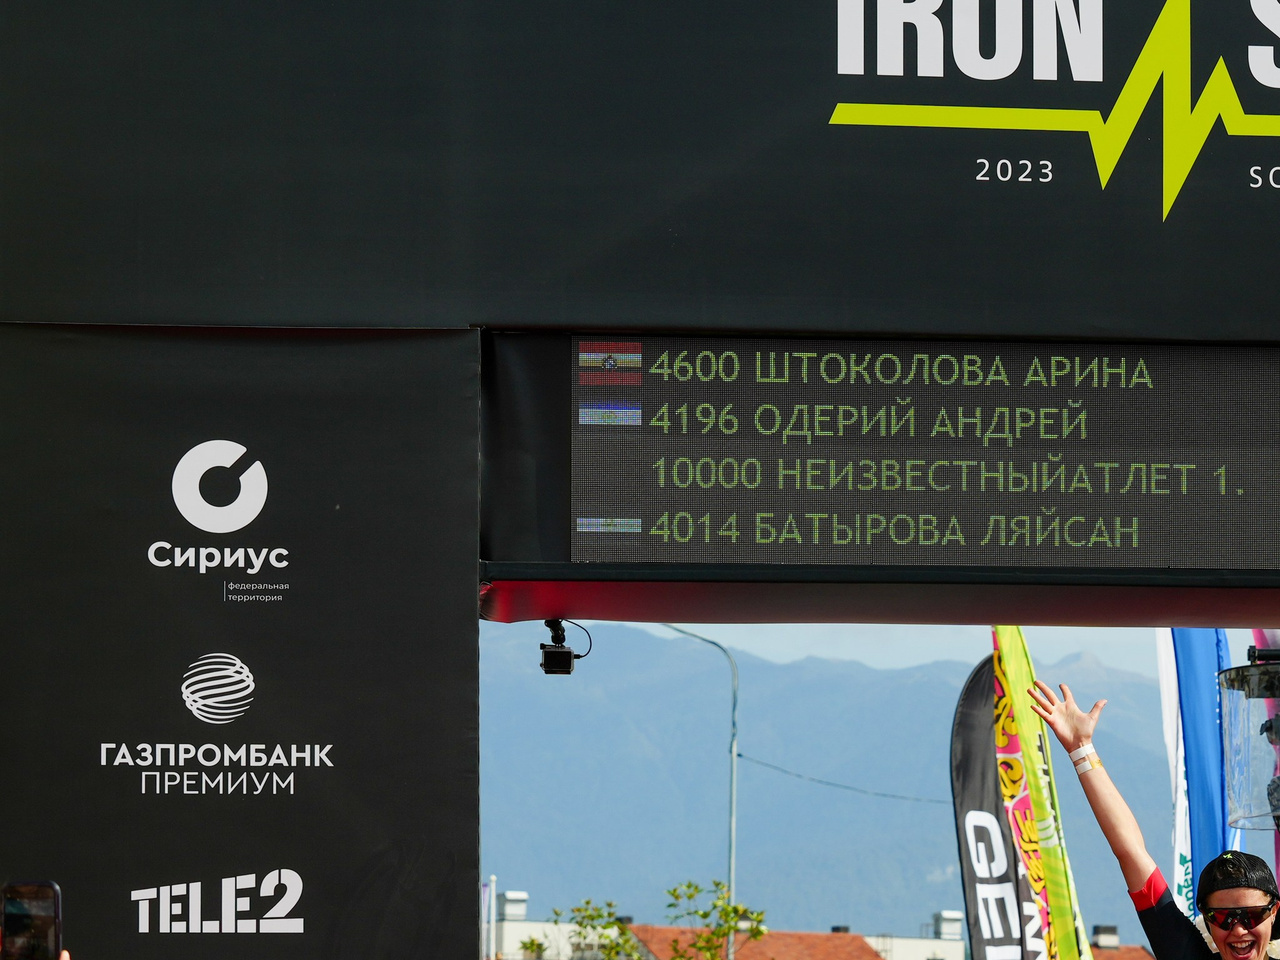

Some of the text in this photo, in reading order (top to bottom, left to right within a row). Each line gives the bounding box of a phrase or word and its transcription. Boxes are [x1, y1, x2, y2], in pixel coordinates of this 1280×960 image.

[837, 0, 1103, 82] IRON
[975, 158, 1054, 183] 2023
[648, 350, 740, 384] 4600
[755, 351, 1011, 387] ШТОКОЛОВА
[1023, 357, 1154, 389] АРИНА
[648, 403, 740, 434] 4196
[755, 396, 916, 444] ОДЕРИЙ
[930, 399, 1088, 447] АНДРЕЙ
[652, 457, 762, 491] 10000
[648, 511, 740, 544] 4014
[755, 511, 965, 546] БАТЫРОВА
[980, 507, 1139, 548] ЛЯЙСАН
[147, 541, 289, 574] Сириус
[228, 581, 290, 591] федеральная
[228, 593, 283, 602] территория
[100, 743, 334, 767] ГАЗПРОМБАНК
[141, 771, 295, 795] ПРЕМИУМ
[131, 868, 304, 933] TELE2
